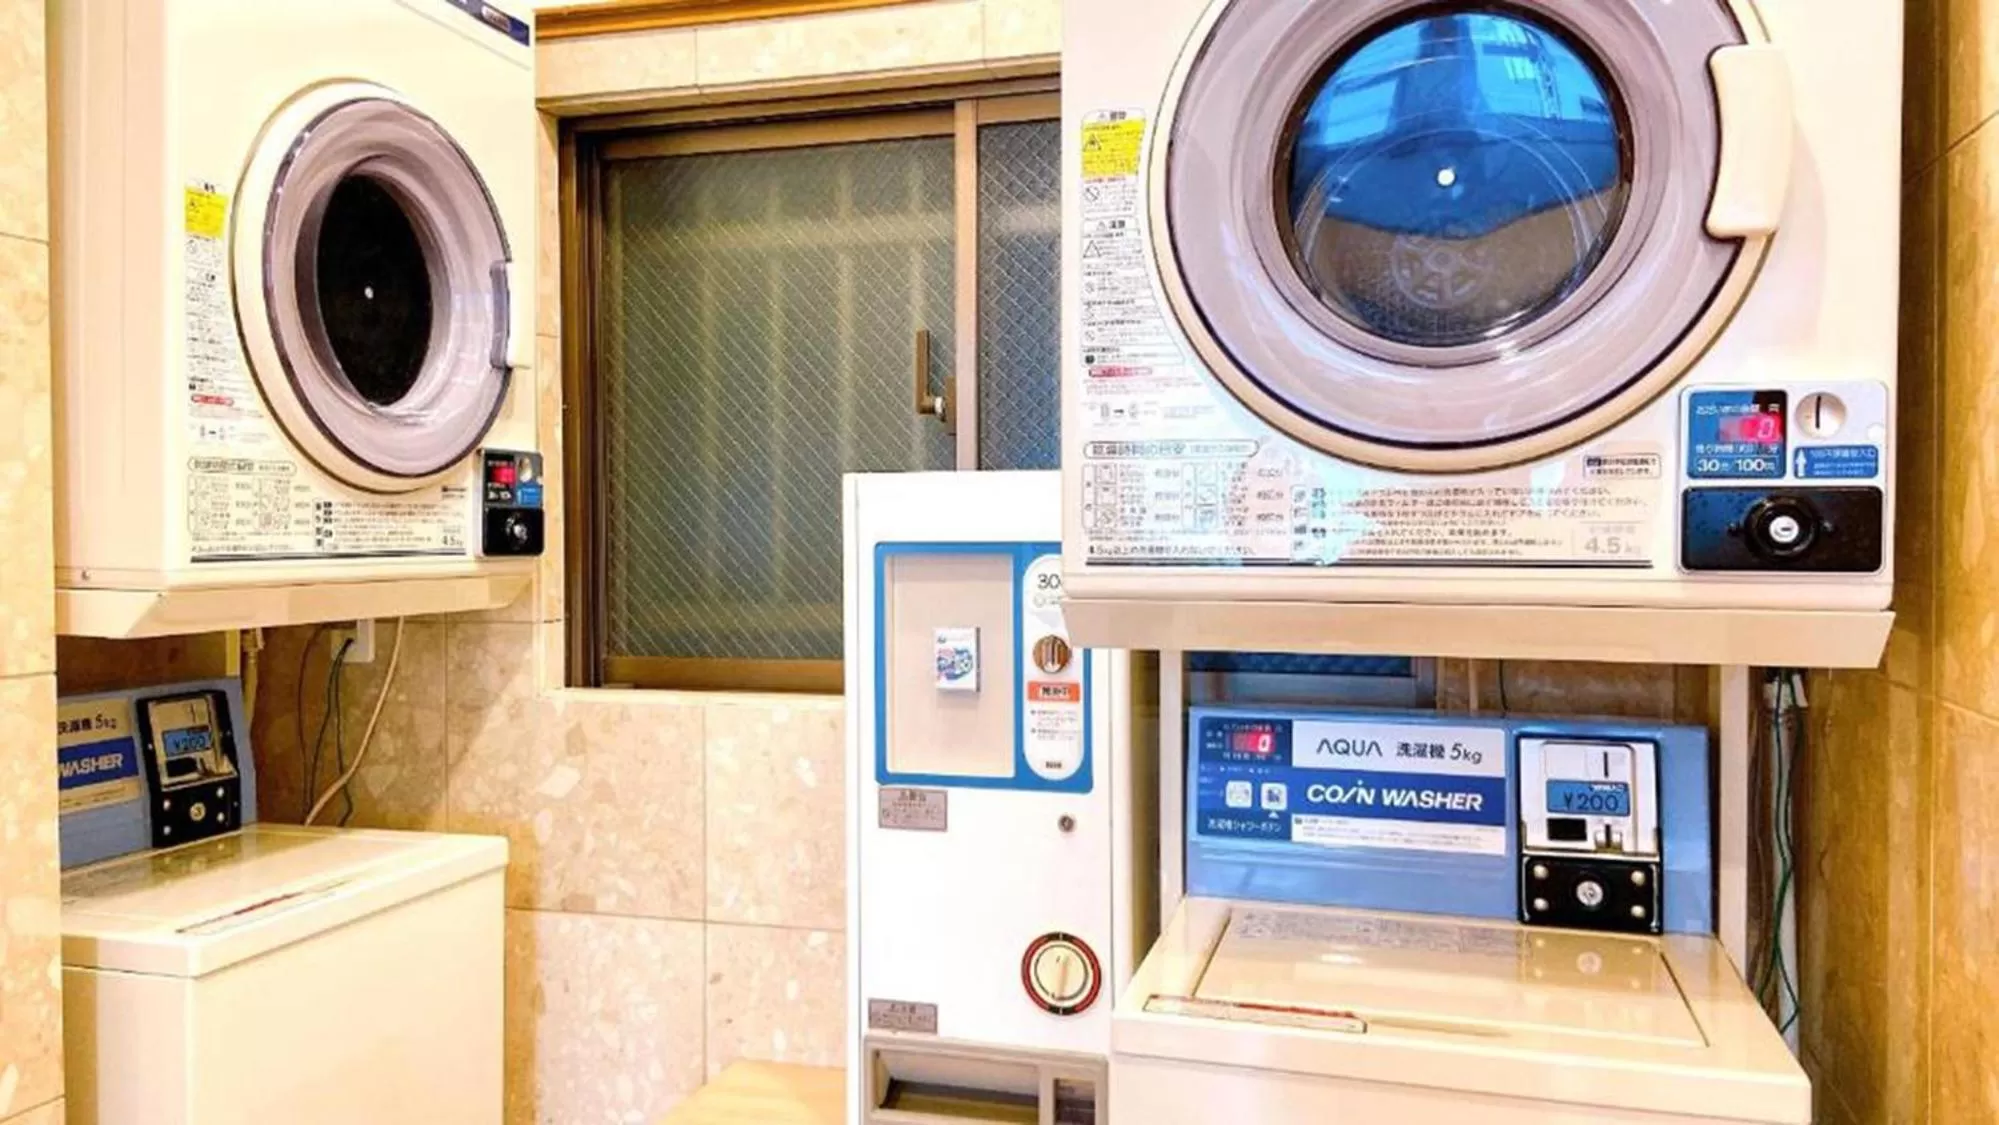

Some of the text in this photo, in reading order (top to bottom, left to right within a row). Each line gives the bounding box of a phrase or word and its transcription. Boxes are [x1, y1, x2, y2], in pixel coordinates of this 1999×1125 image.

[1316, 738, 1483, 765] AQUA 洗濯機 5kg
[1382, 788, 1483, 812] WASHER
[1563, 792, 1619, 812] ¥200
